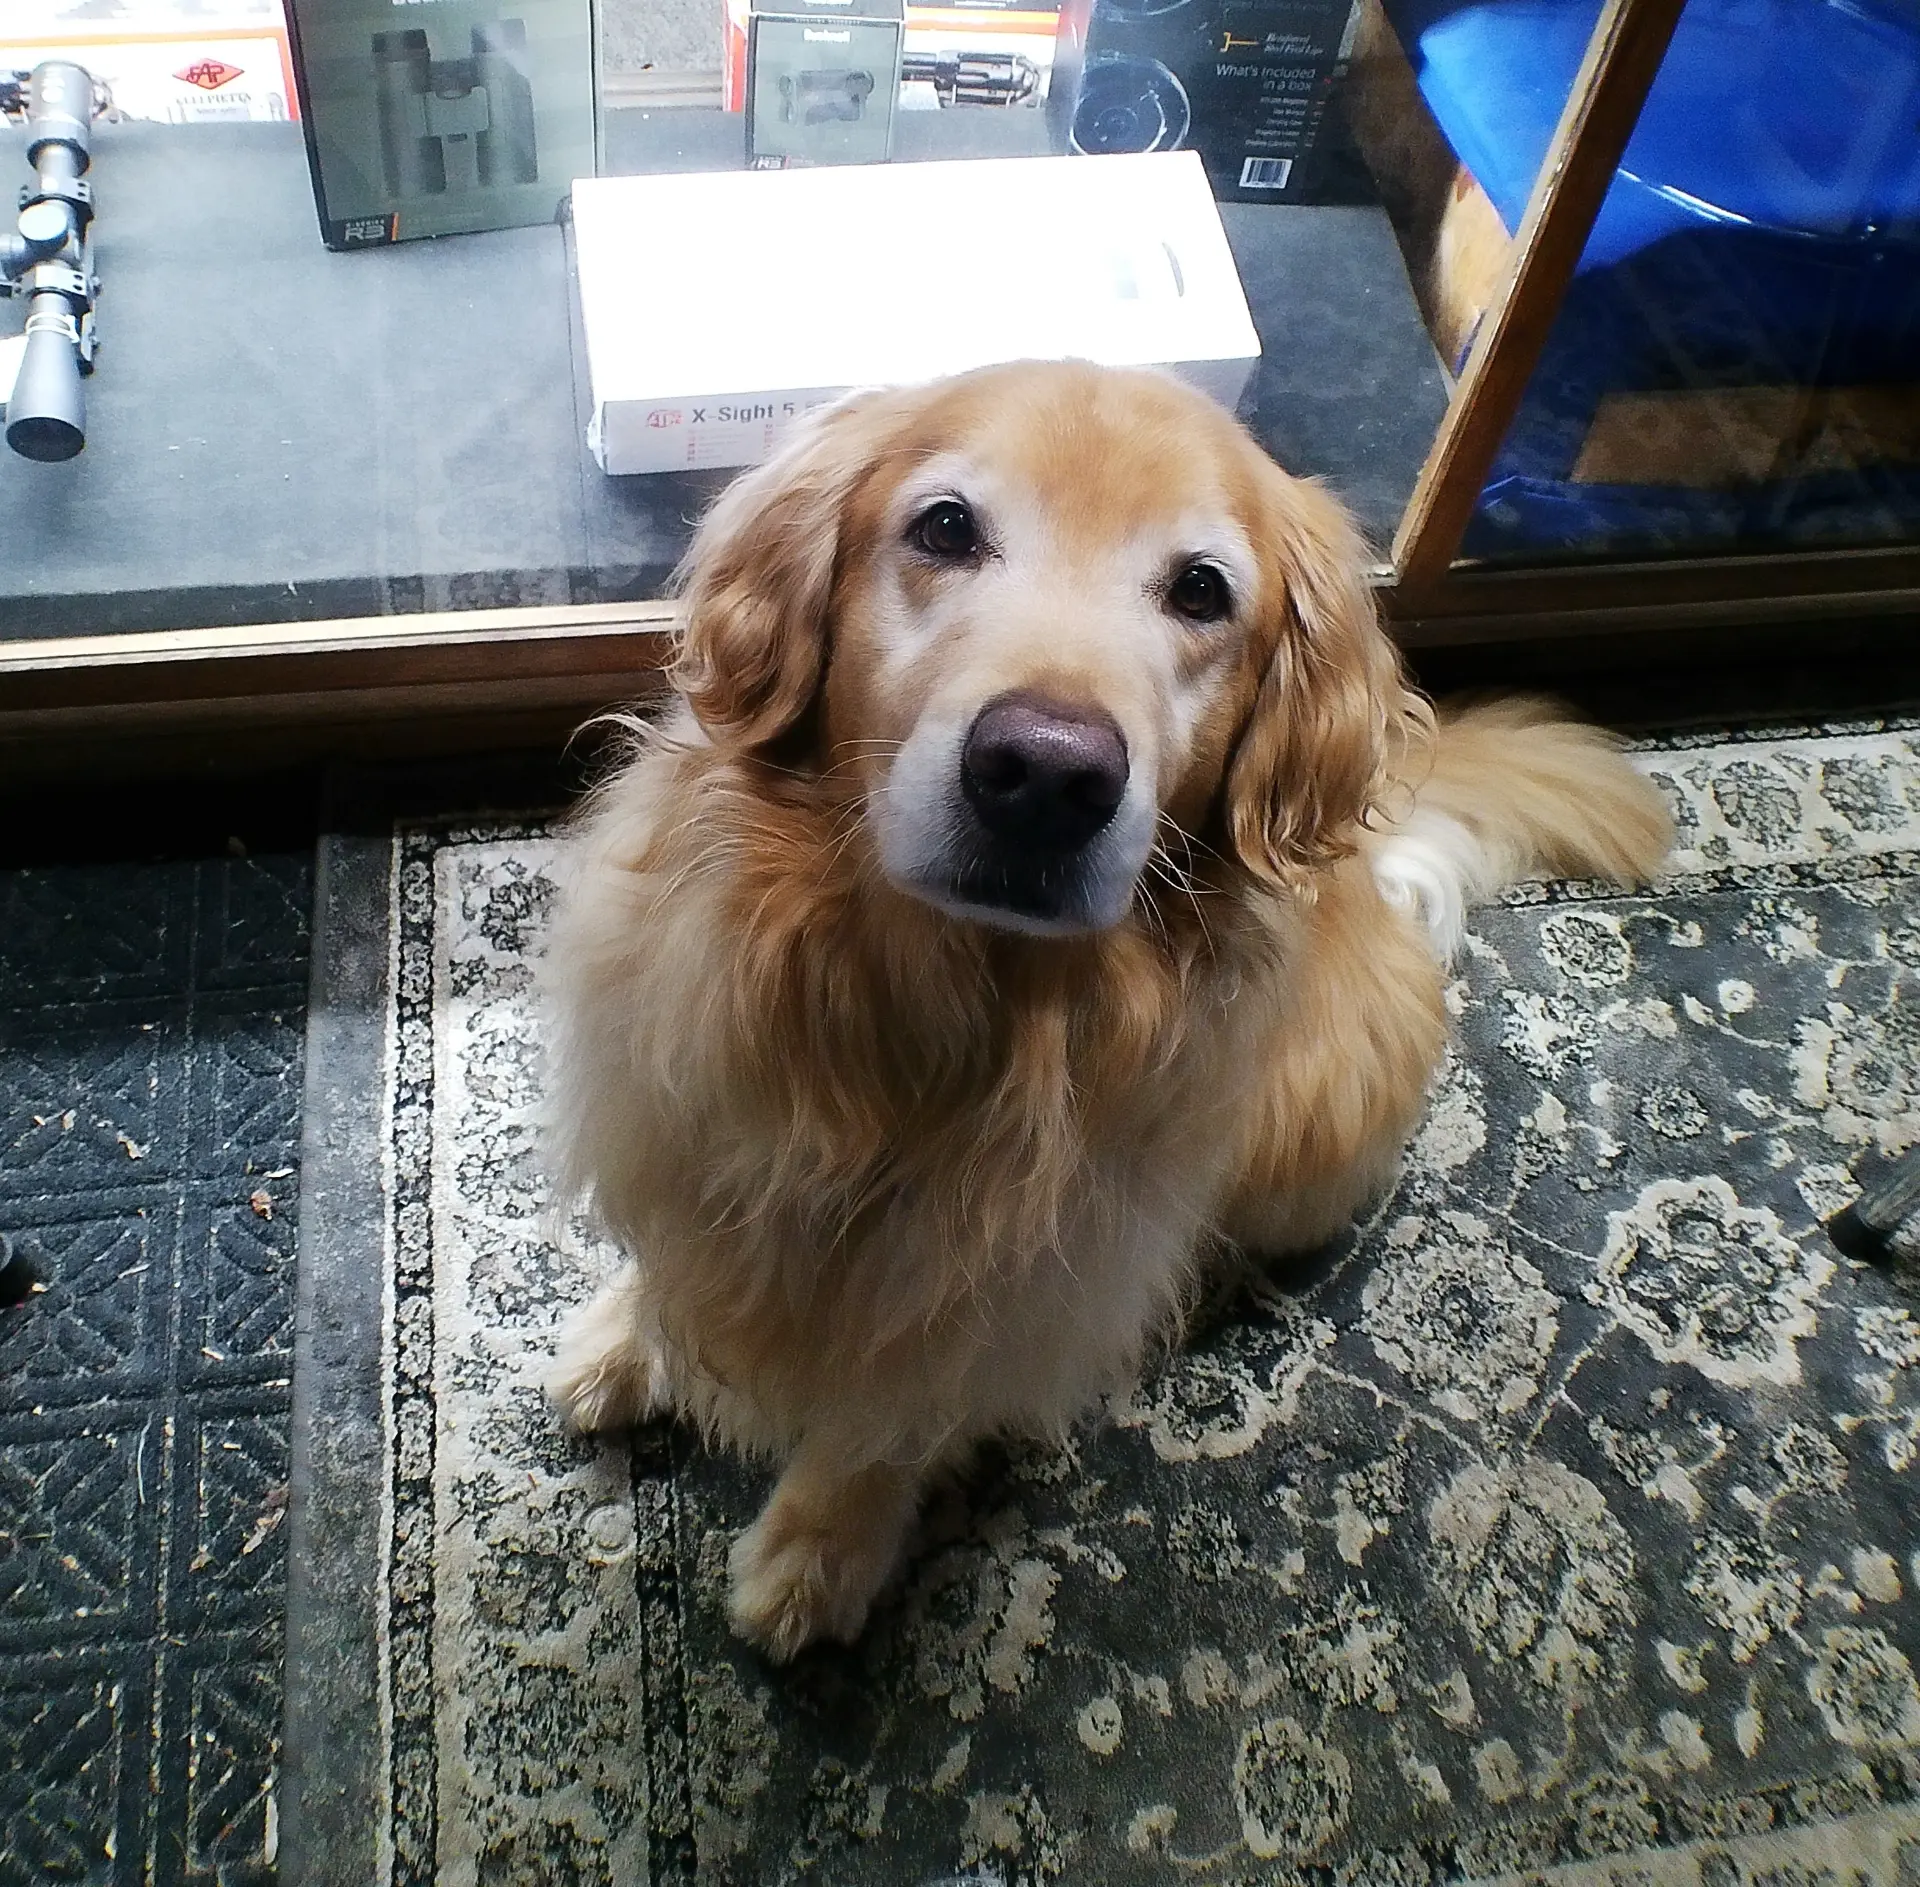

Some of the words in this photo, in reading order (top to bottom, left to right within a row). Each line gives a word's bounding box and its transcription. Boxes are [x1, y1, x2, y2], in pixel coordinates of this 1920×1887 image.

[1216, 63, 1259, 77] What's
[1263, 80, 1275, 90] in
[1277, 81, 1286, 91] a
[1287, 81, 1313, 91] box
[344, 225, 386, 242] R3
[692, 404, 774, 424] X-Sight
[783, 402, 795, 418] 5
